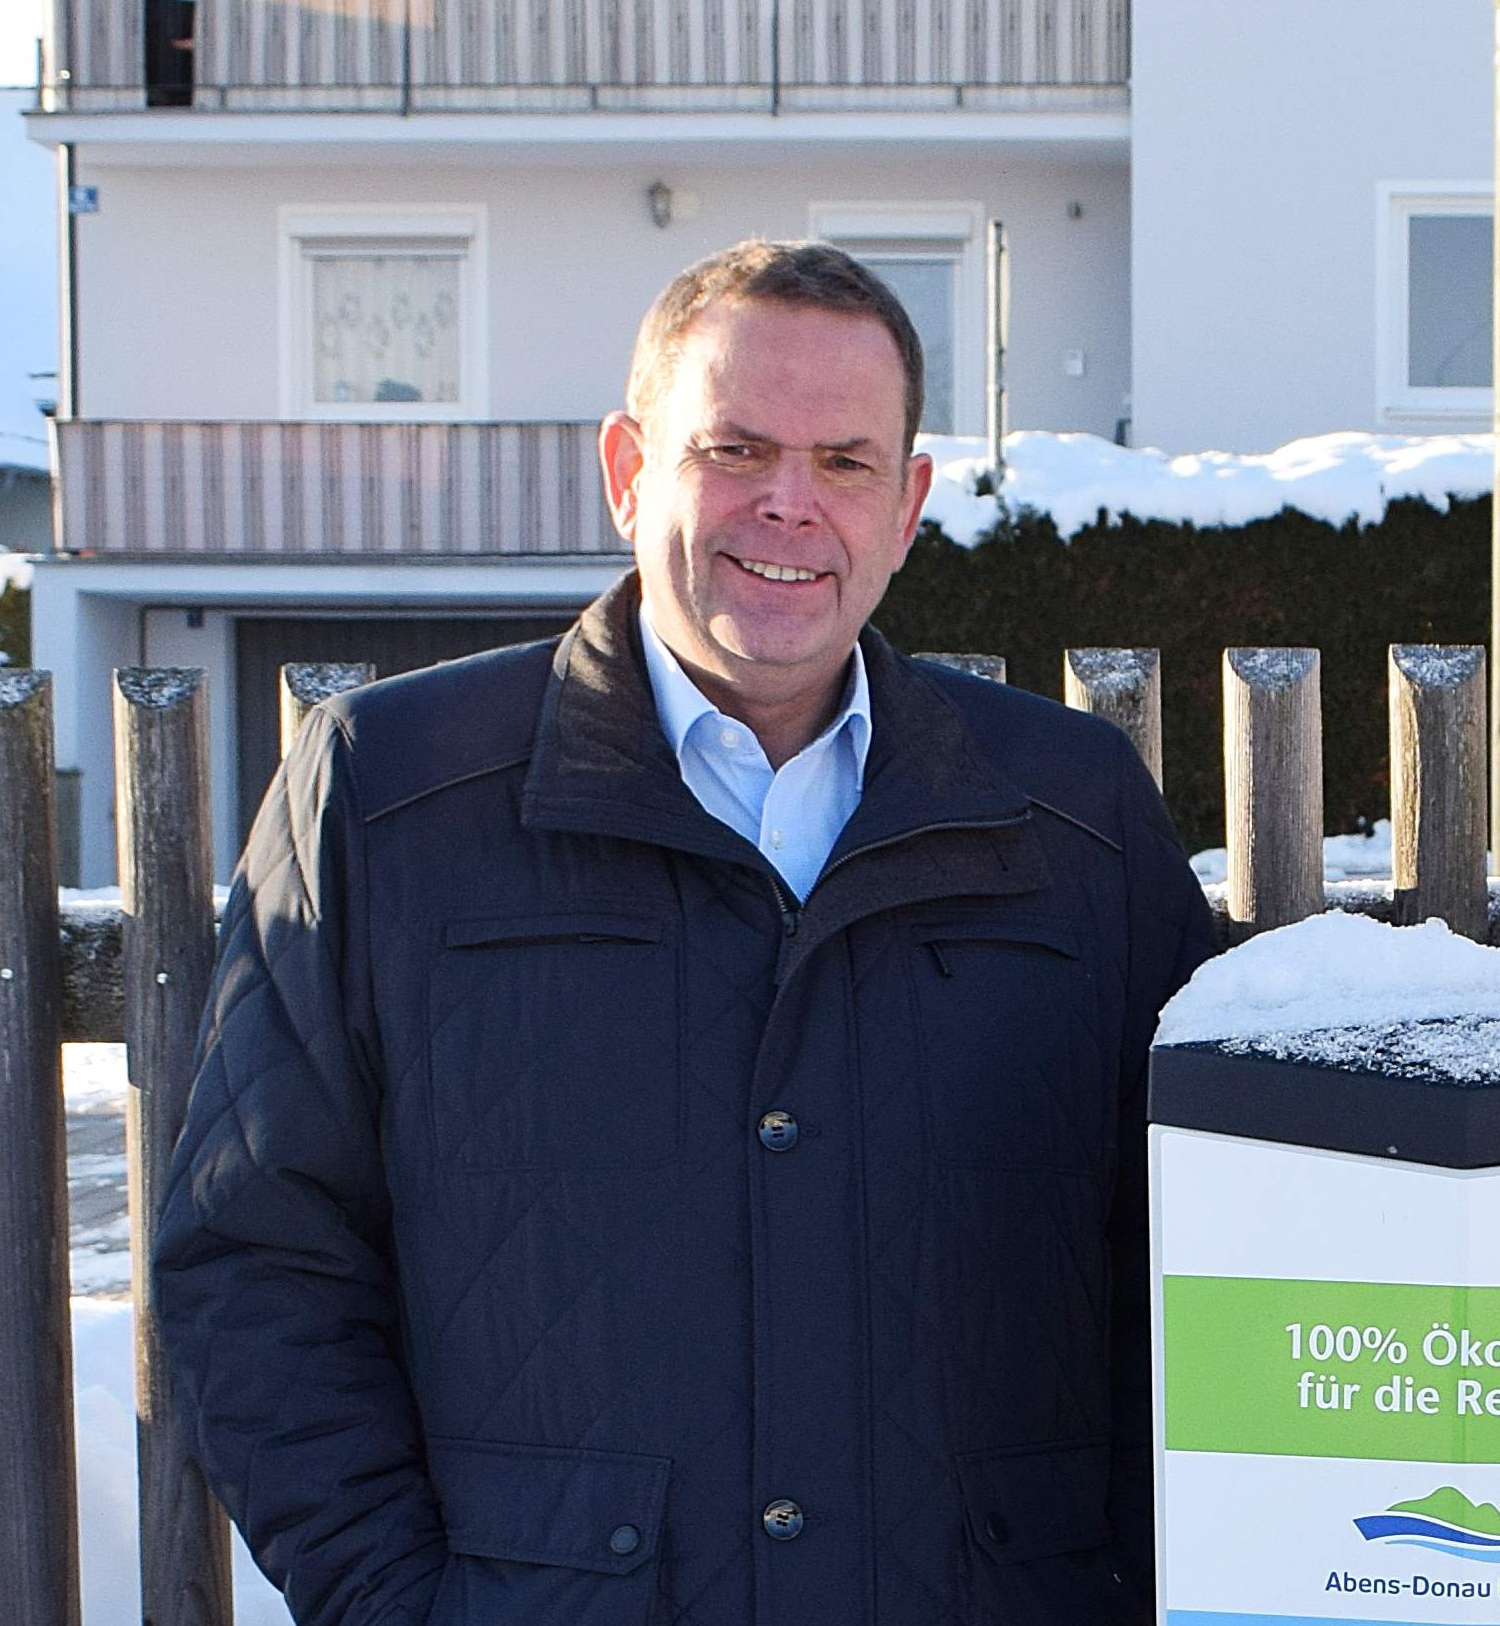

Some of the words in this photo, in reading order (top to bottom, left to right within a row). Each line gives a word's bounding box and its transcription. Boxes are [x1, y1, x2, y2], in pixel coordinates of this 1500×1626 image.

[1285, 1323, 1408, 1364] 100%
[1296, 1371, 1361, 1410] für
[1374, 1375, 1440, 1414] die
[1324, 1571, 1491, 1598] Abens-Donau
